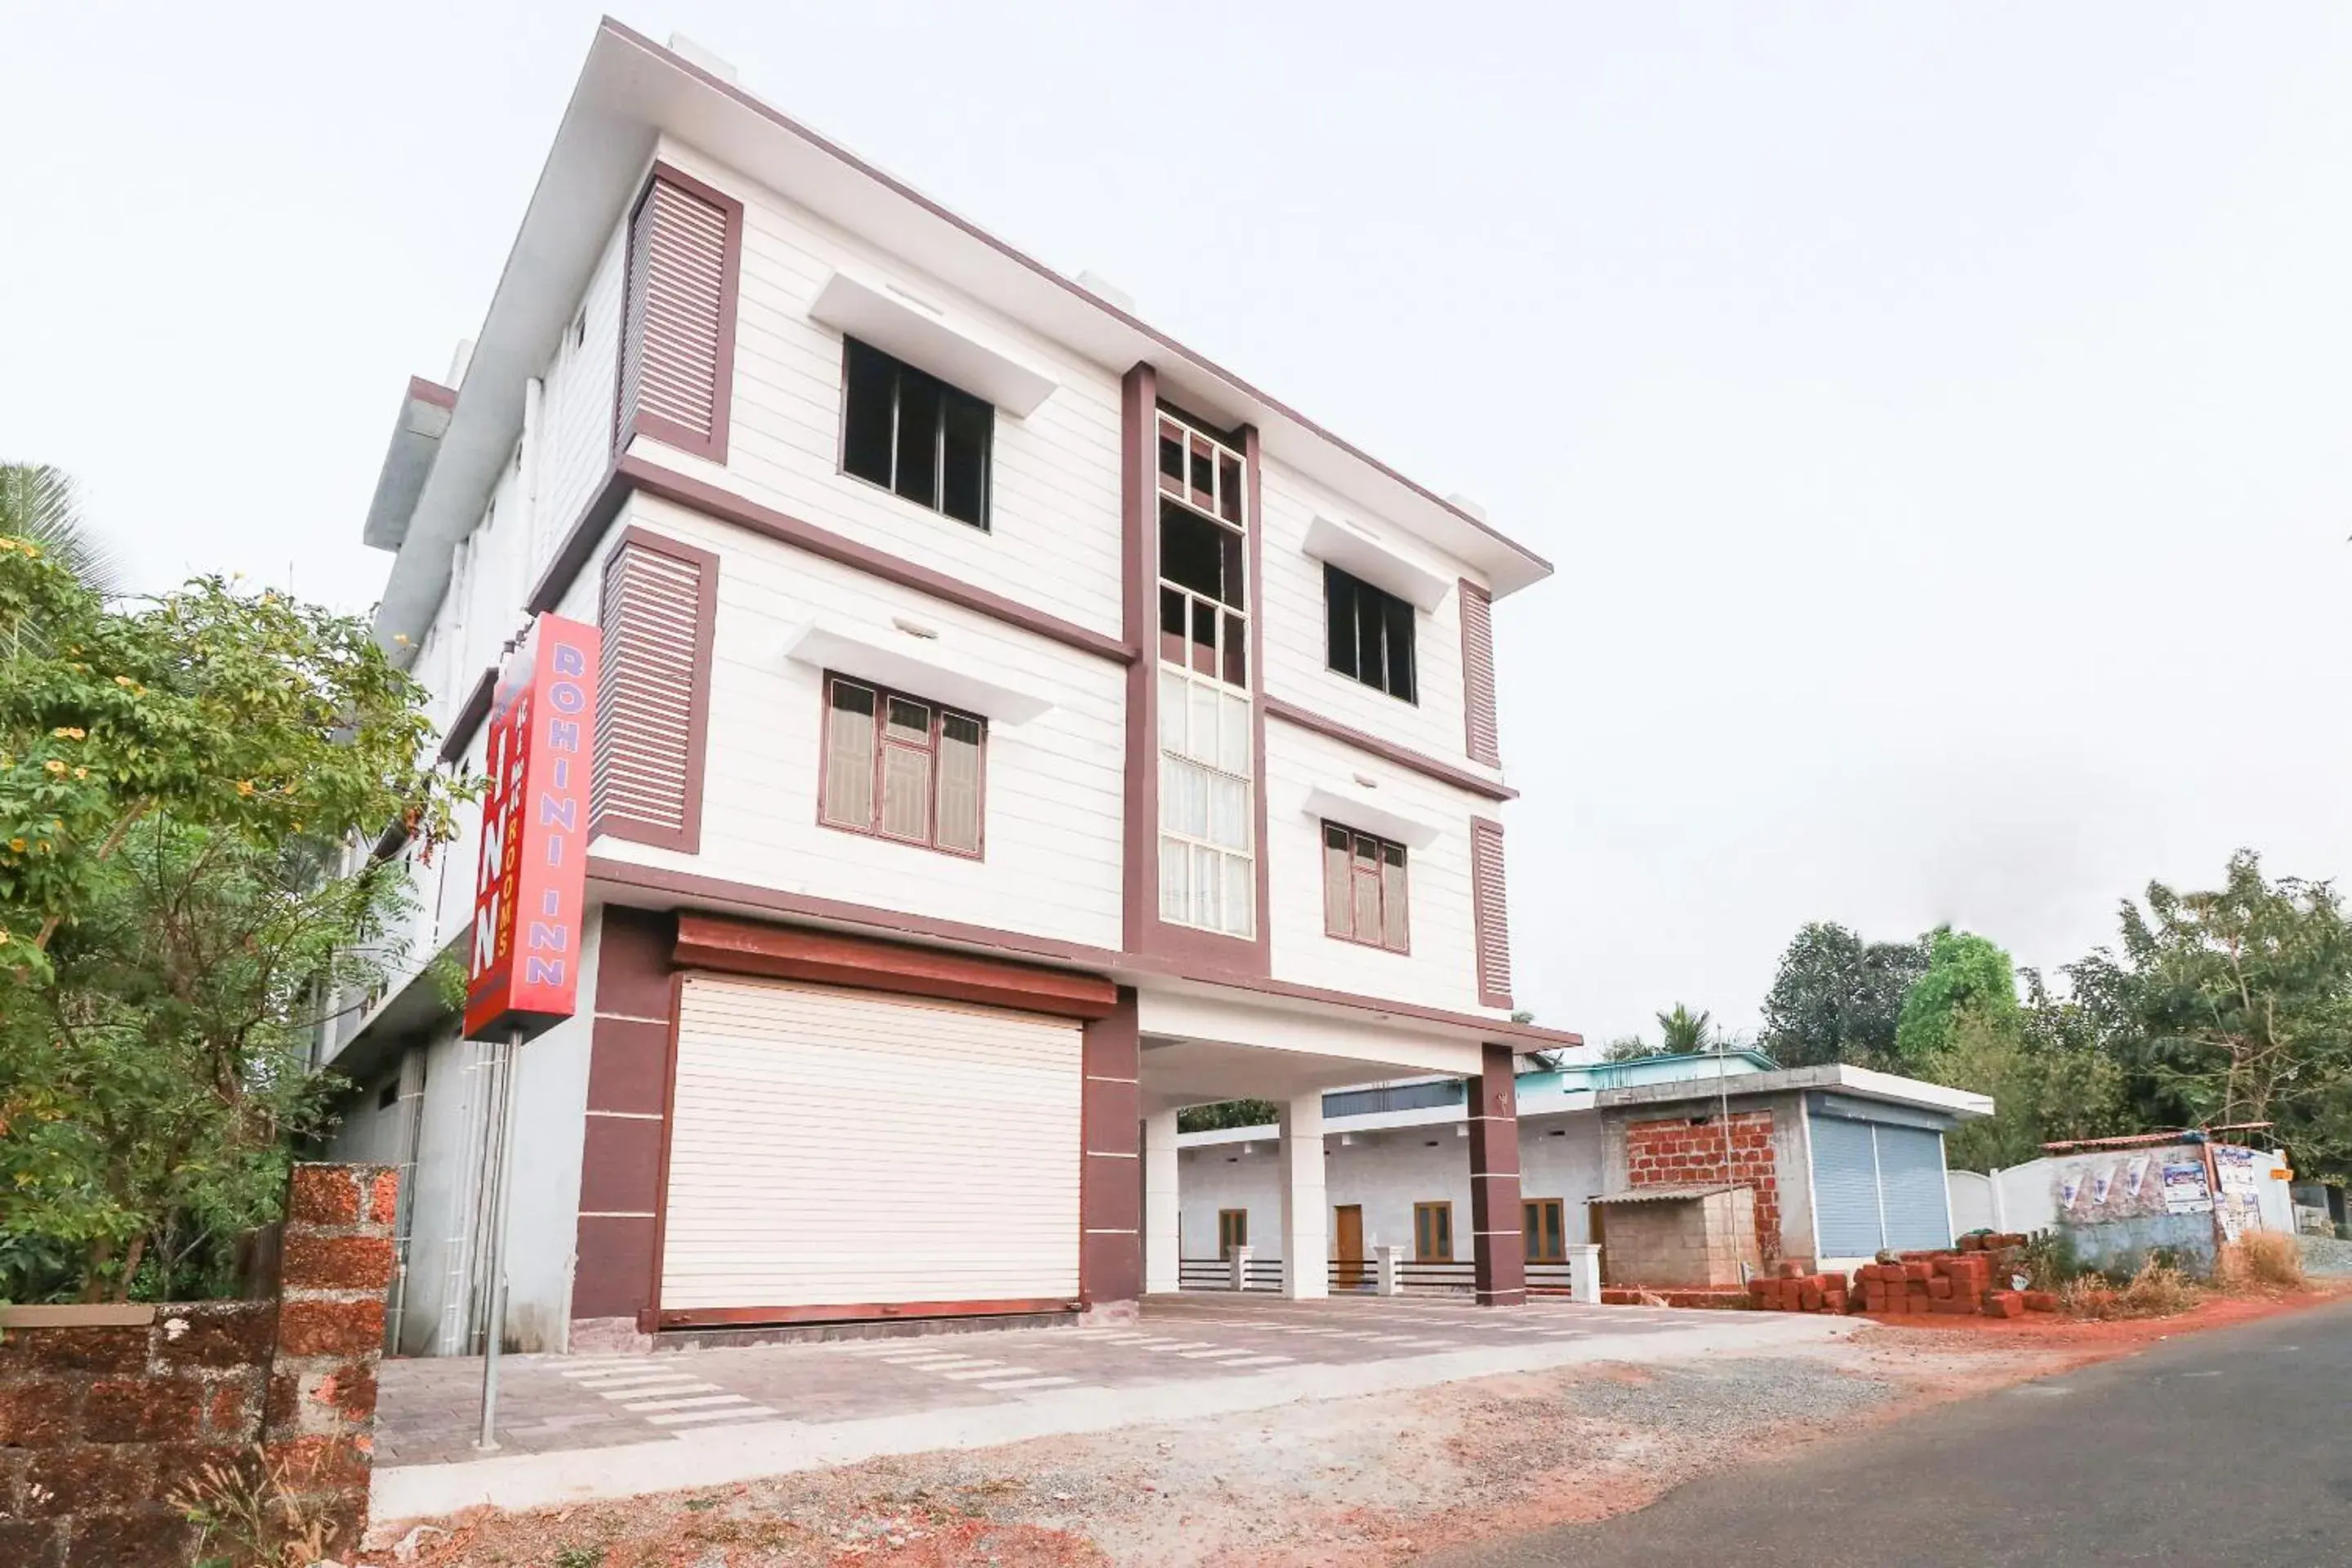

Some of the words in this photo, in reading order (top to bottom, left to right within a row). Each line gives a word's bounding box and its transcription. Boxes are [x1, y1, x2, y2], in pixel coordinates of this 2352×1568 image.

[540, 643, 586, 867] ROHINI
[472, 726, 508, 981] INN
[498, 817, 518, 957] ROOMS
[526, 889, 568, 987] INN
